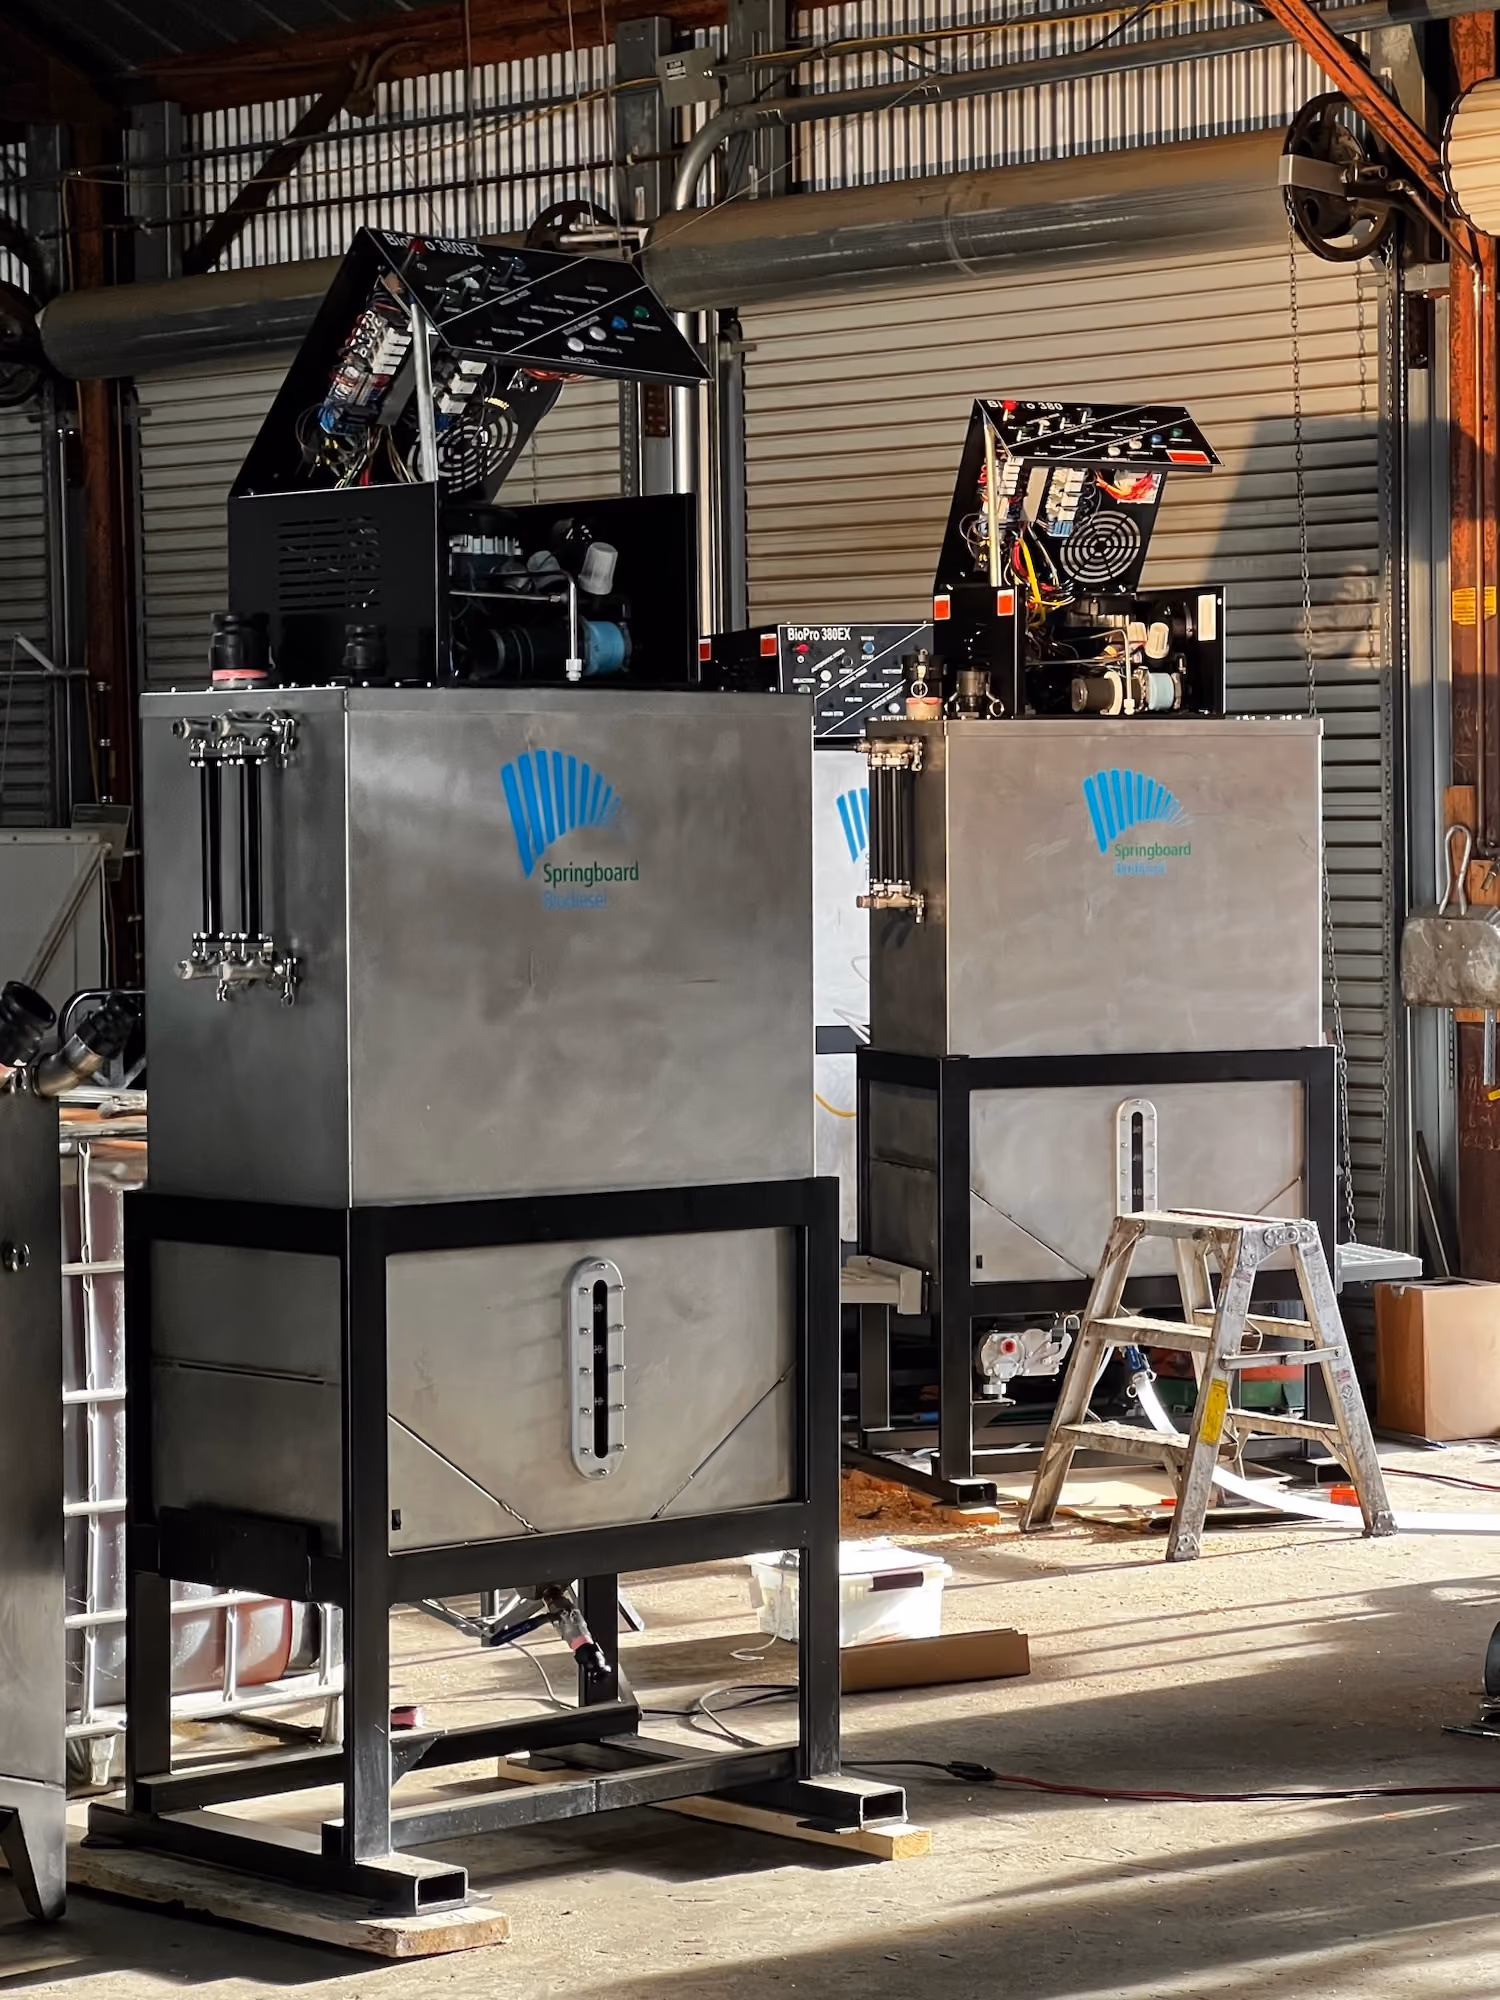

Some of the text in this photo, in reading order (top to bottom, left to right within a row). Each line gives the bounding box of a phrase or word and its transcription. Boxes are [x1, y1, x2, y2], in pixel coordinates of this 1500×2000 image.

[434, 239, 485, 258] 380EX
[1038, 402, 1064, 411] 380
[787, 627, 852, 641] BioPro 380EX
[1115, 842, 1192, 861] Springboard
[543, 860, 640, 889] Springboard
